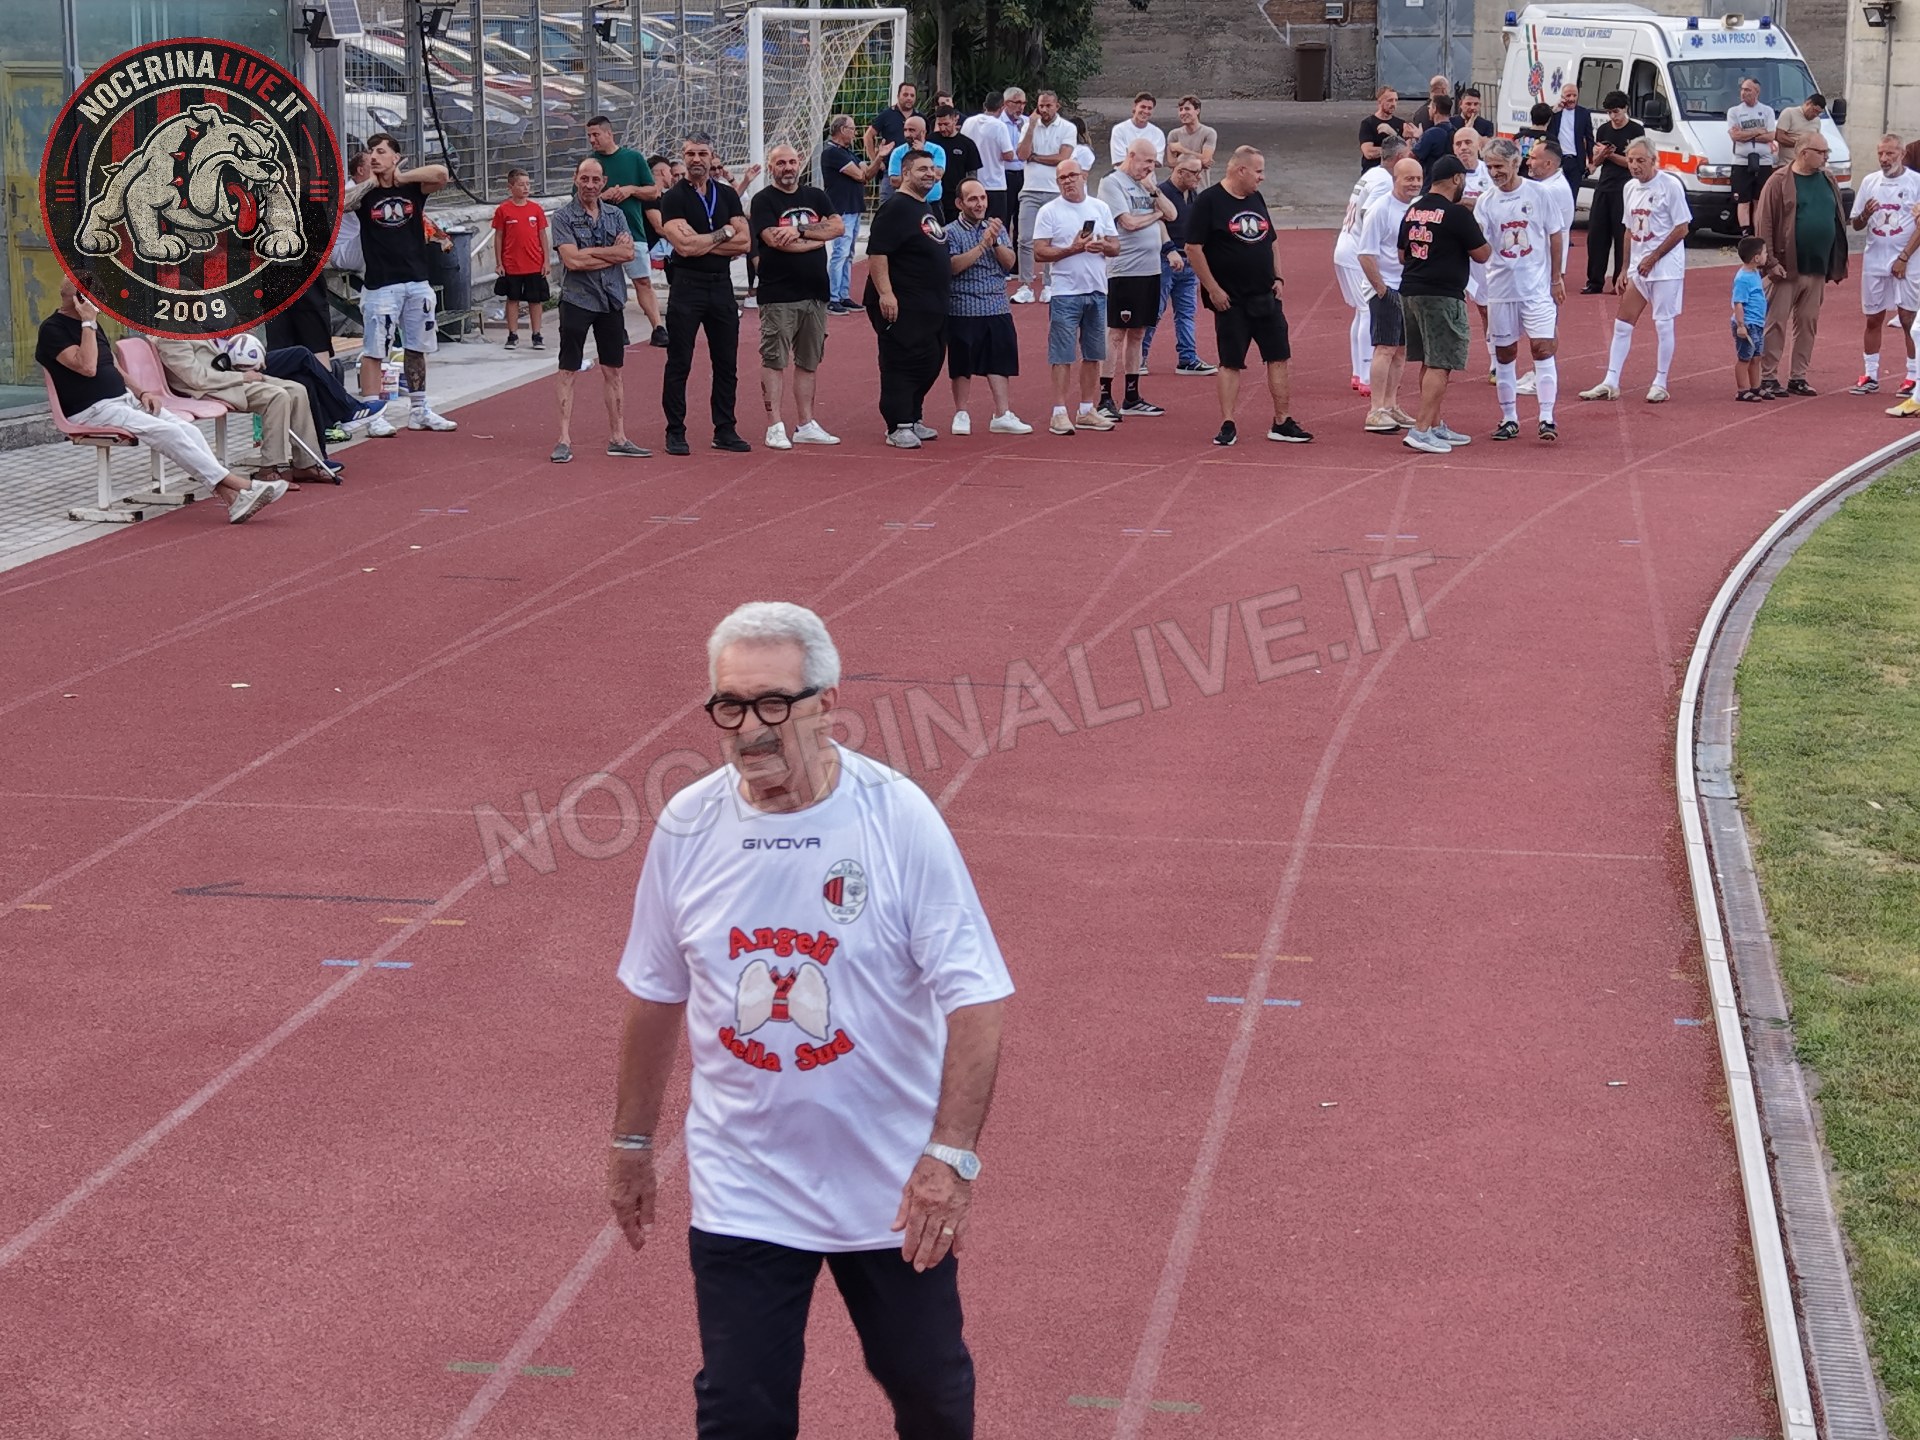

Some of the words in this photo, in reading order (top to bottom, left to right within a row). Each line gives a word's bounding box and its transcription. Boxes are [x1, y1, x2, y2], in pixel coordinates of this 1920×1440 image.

[1586, 28, 1596, 38] SAN
[1596, 28, 1613, 39] PRISCO
[1711, 33, 1727, 44] SAN
[1728, 32, 1756, 43] PRISCO
[1405, 207, 1445, 225] Angeli
[742, 837, 821, 850] GIVOVA
[728, 926, 839, 966] Angeli
[718, 1025, 783, 1073] della
[794, 1028, 855, 1071] Sud
